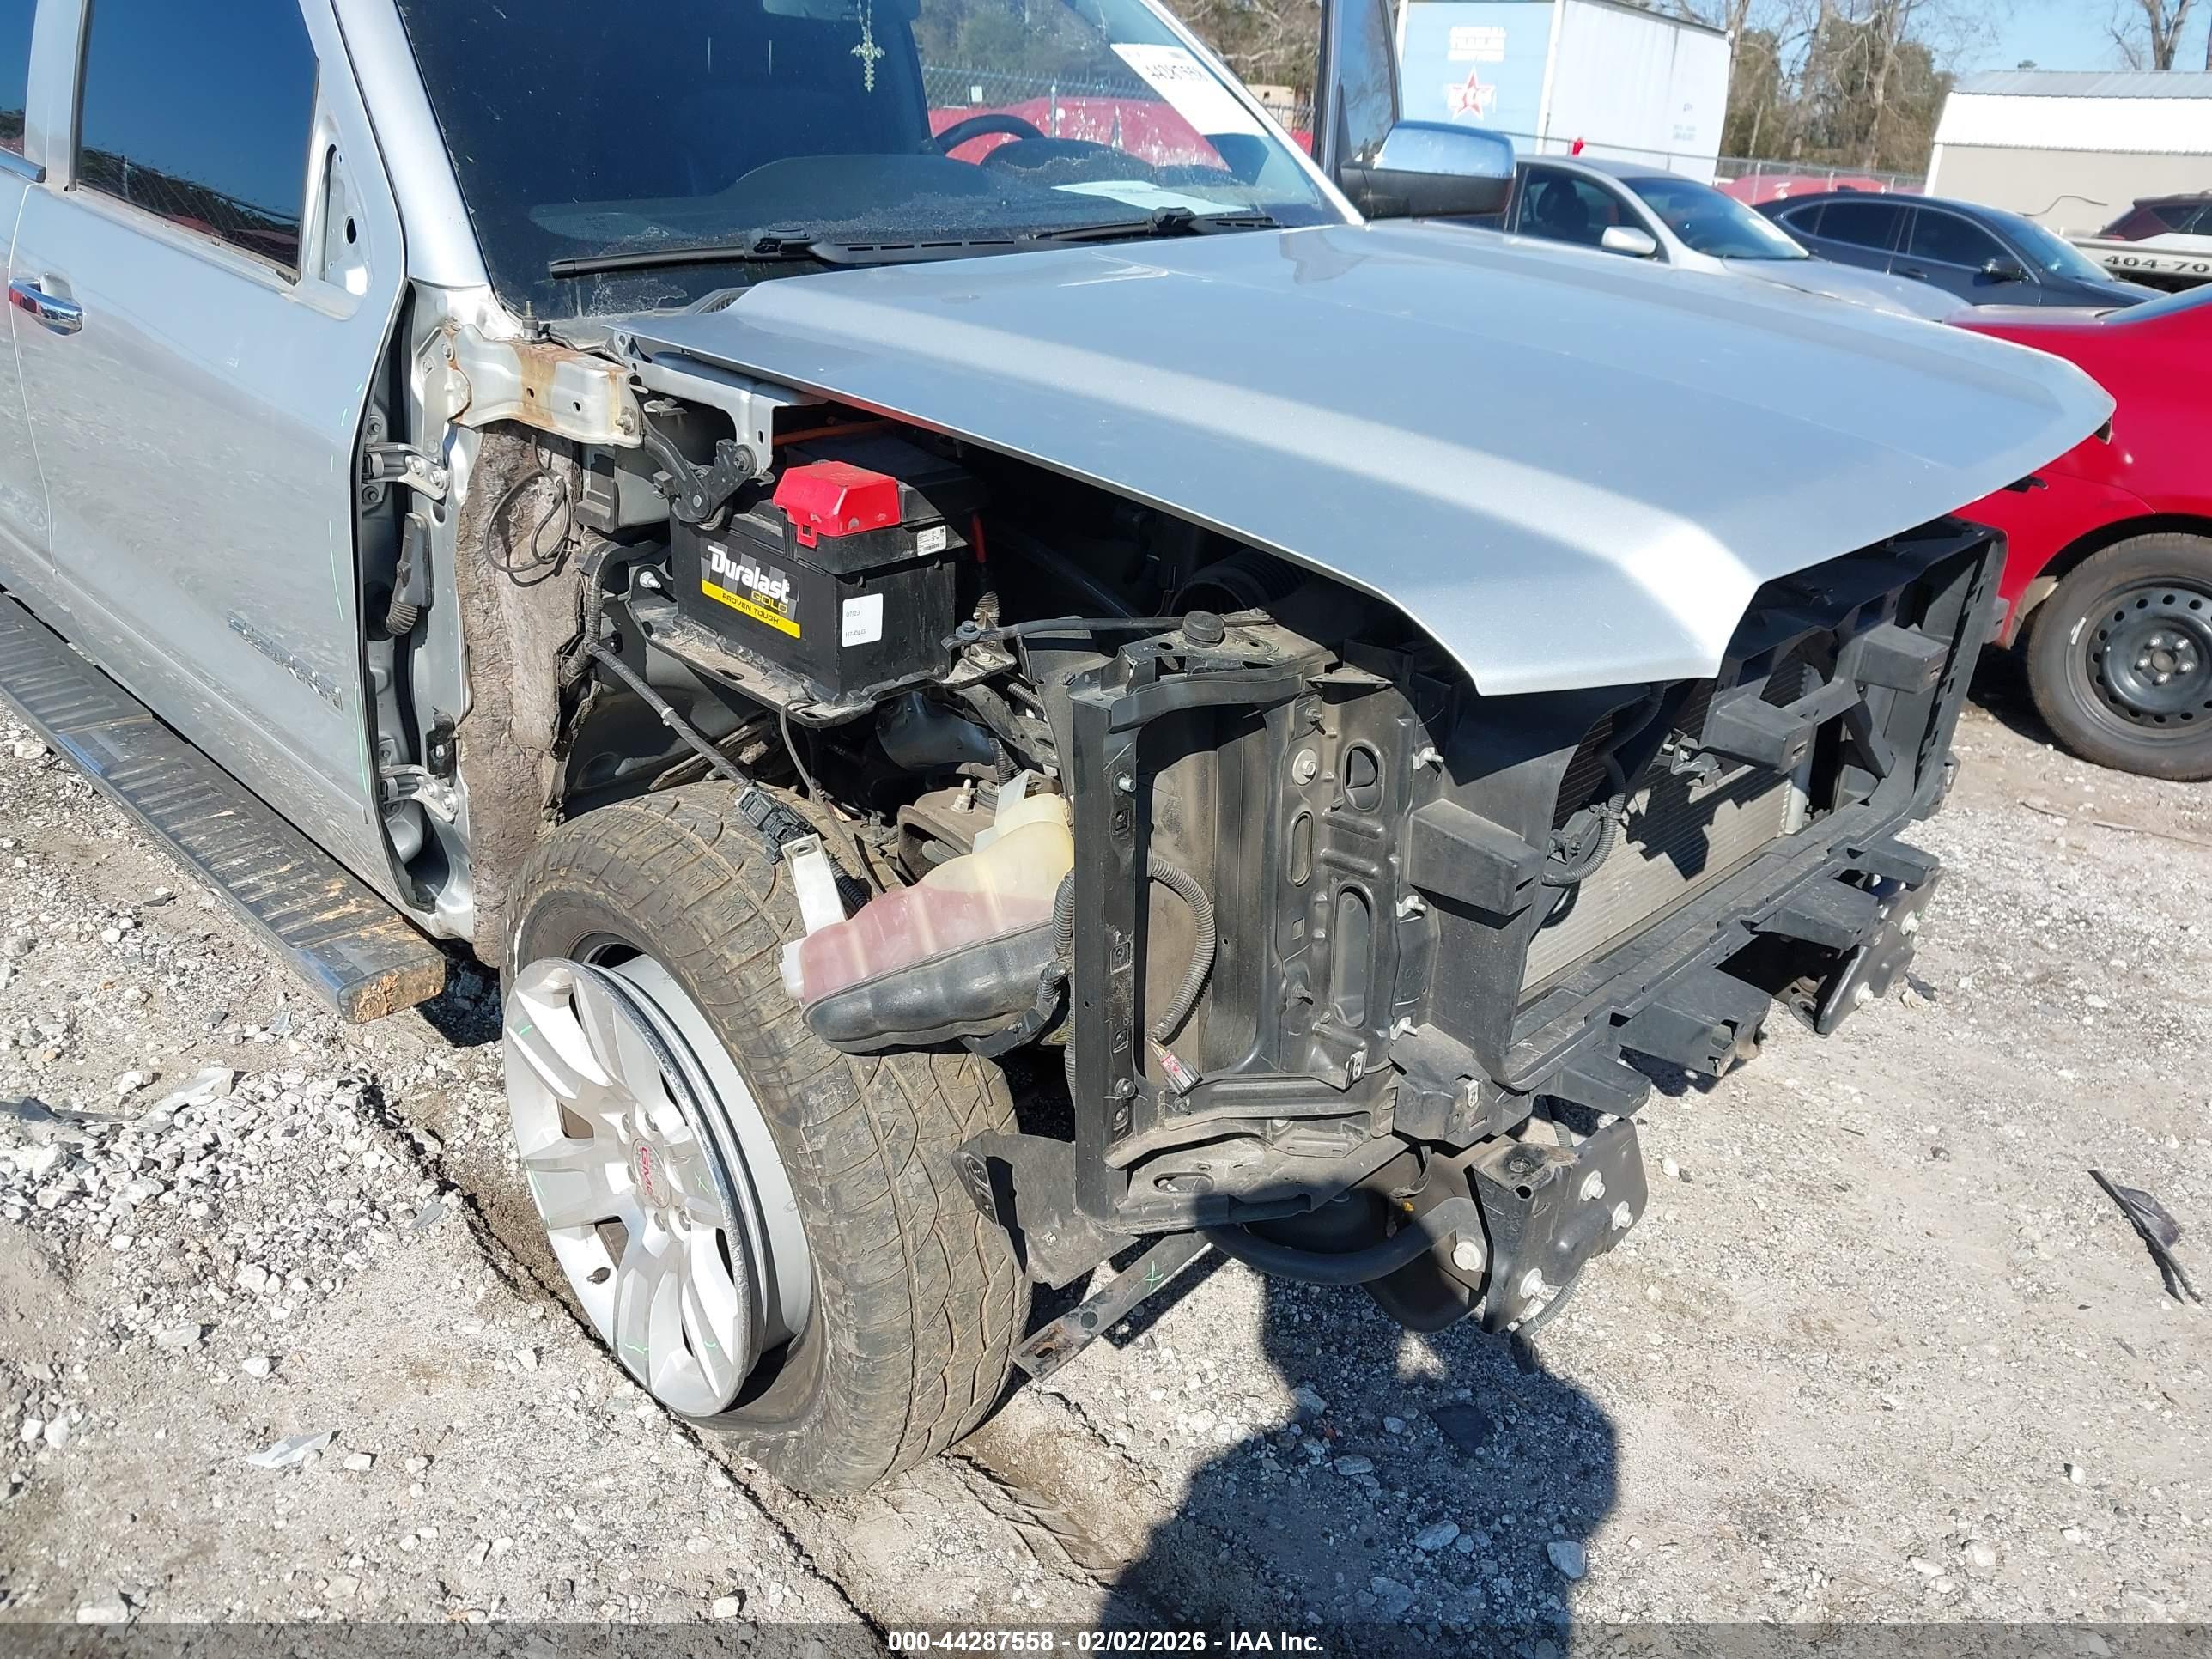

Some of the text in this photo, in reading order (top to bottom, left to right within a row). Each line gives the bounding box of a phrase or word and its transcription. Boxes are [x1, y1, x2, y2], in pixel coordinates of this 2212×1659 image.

[2104, 255, 2210, 273] 404-70
[707, 544, 791, 604] Duralast
[721, 592, 780, 624] PROVEN TOUGH
[751, 590, 789, 614] GOLD
[640, 1146, 653, 1196] GMC
